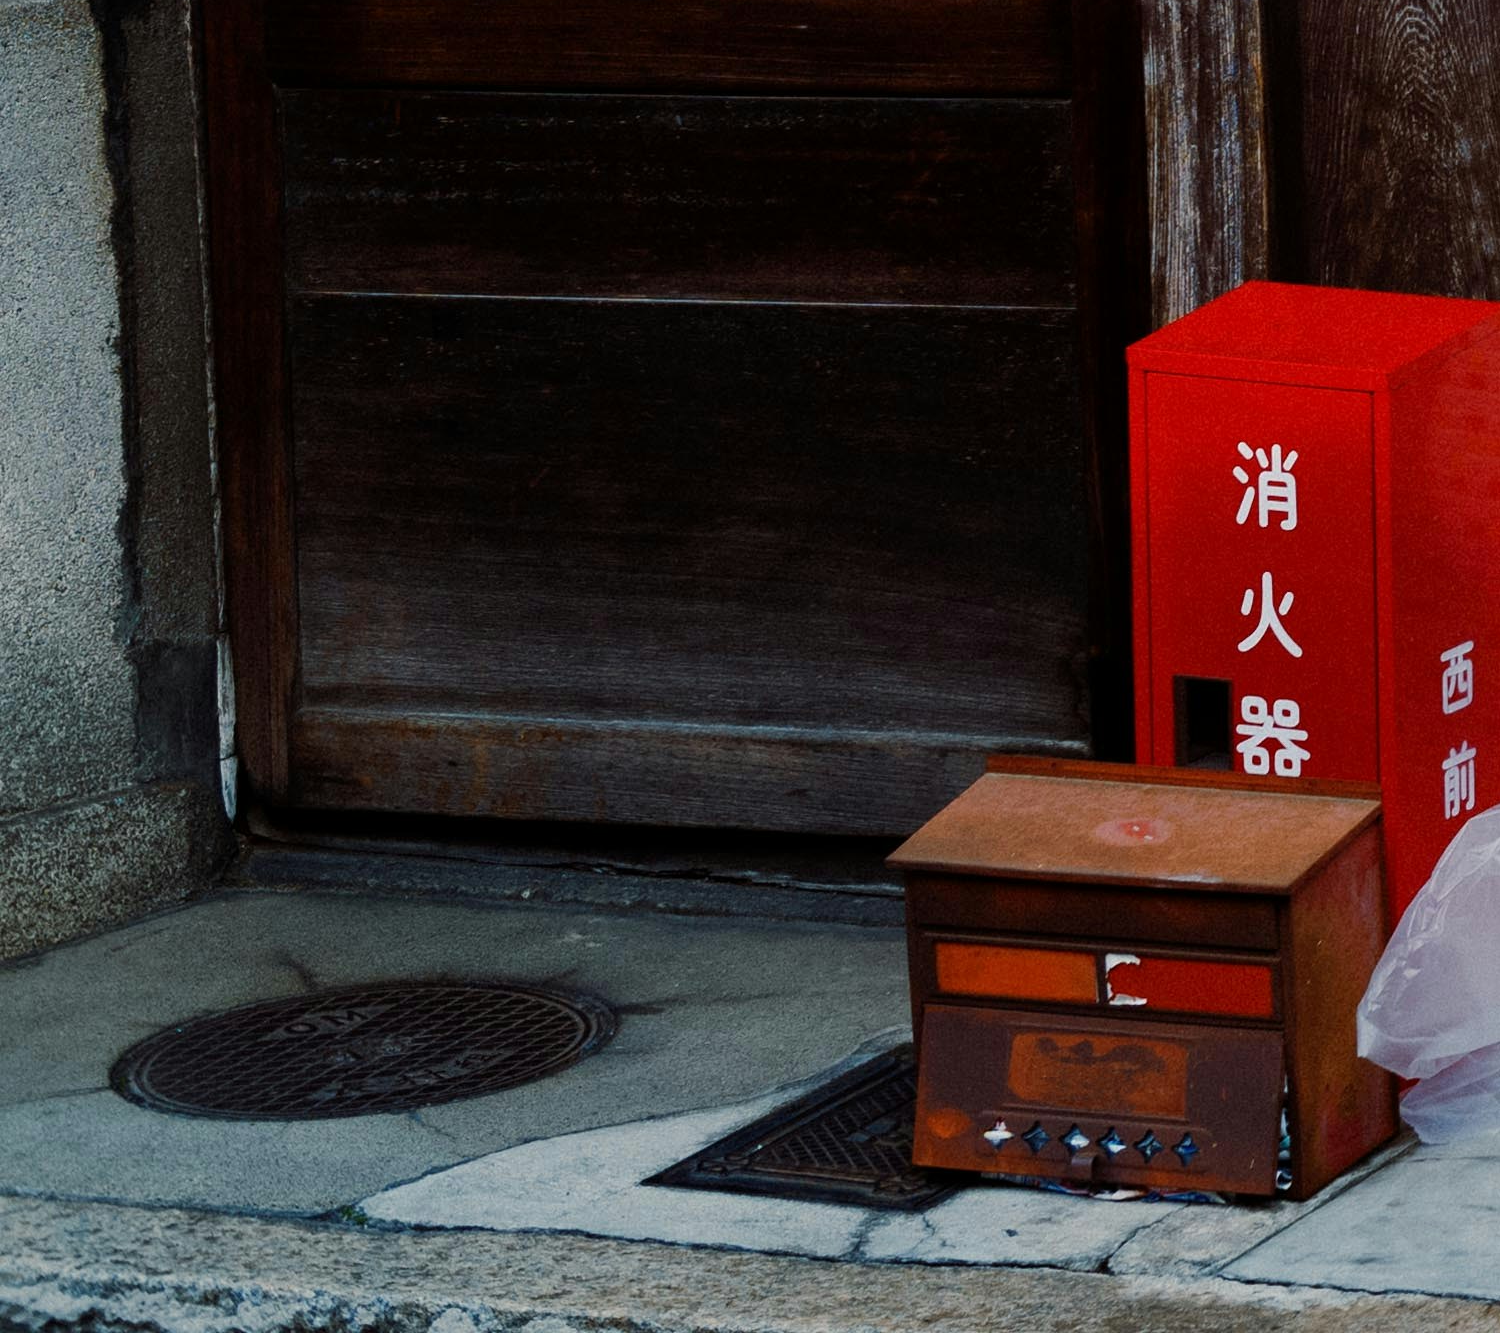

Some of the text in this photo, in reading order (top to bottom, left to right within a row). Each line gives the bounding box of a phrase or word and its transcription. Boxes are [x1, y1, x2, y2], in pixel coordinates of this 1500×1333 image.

[1233, 441, 1310, 778] 消火器
[1441, 640, 1477, 820] 西前
